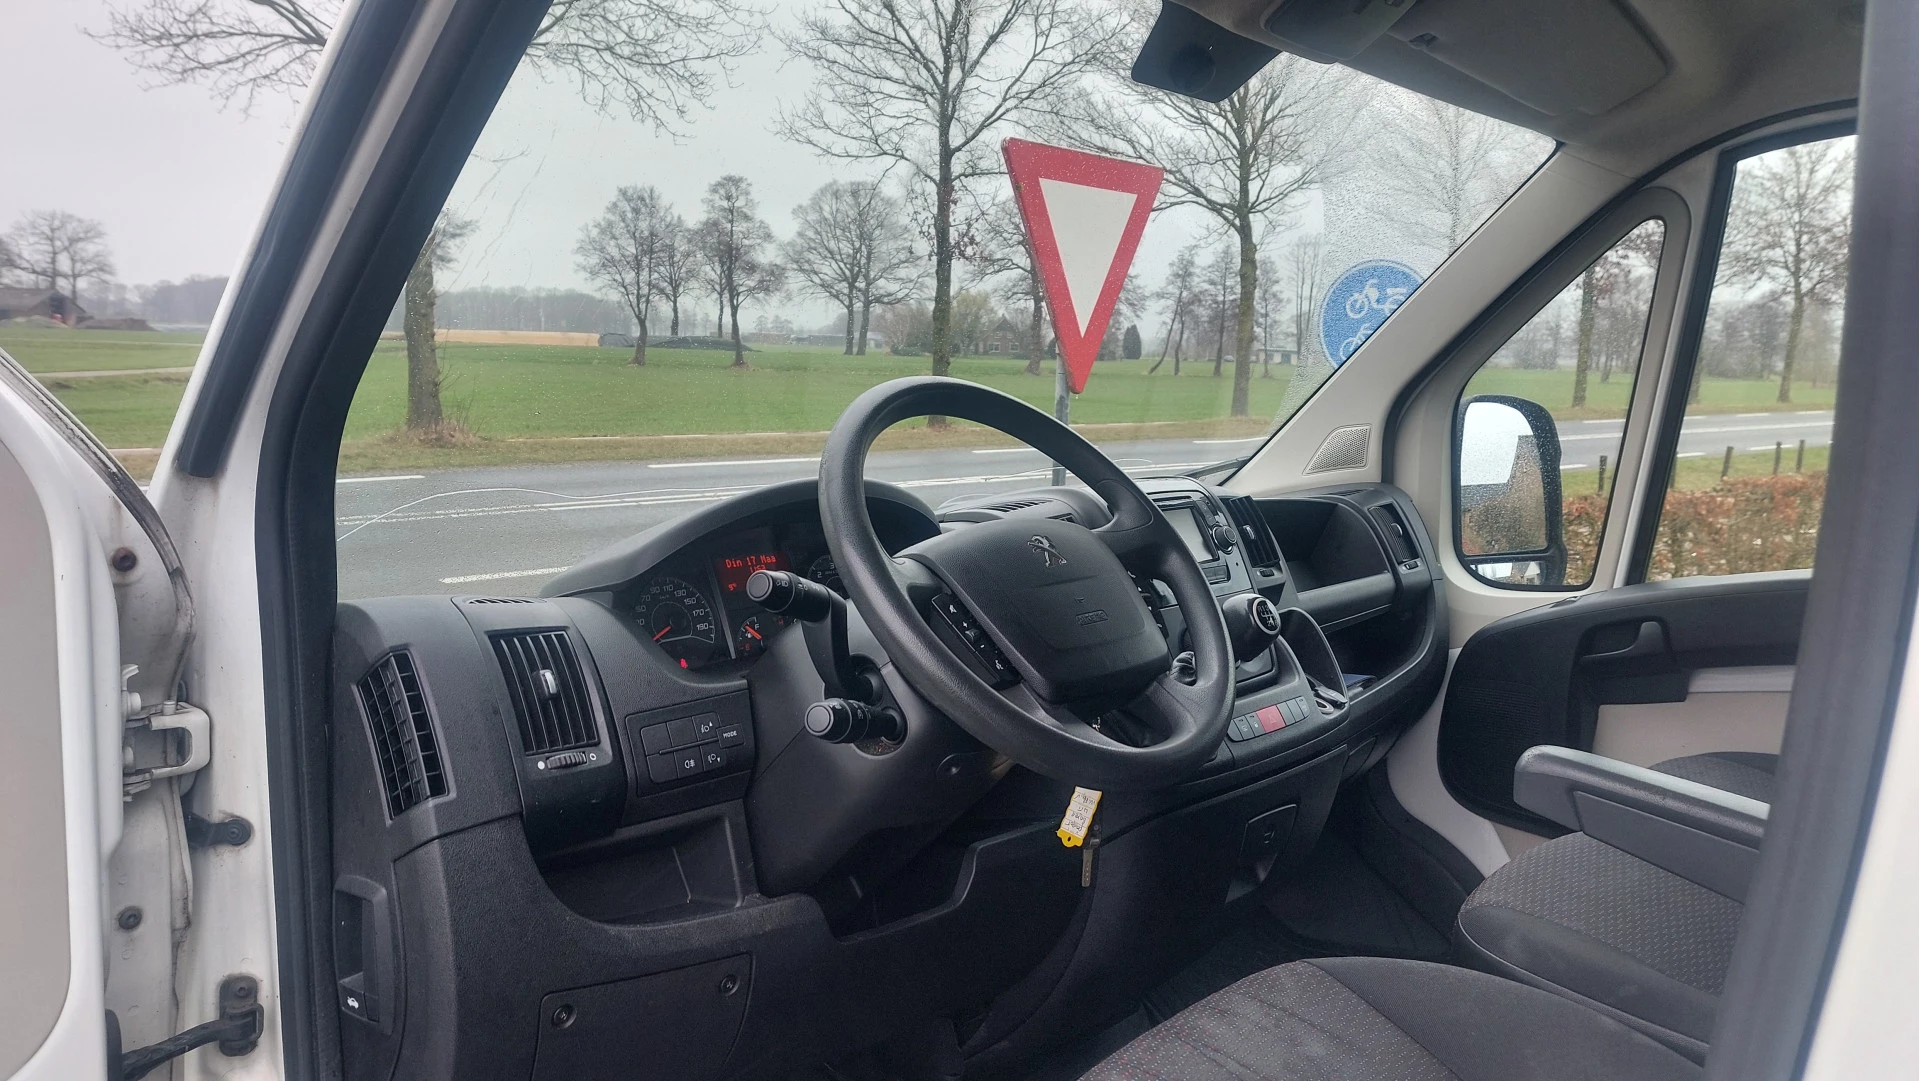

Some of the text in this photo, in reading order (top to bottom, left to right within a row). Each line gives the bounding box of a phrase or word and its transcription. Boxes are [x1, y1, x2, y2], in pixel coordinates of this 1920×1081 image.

[725, 555, 777, 568] Din 17 Maa
[663, 584, 674, 592] 110
[674, 589, 687, 597] 130
[684, 597, 697, 605] 150
[692, 609, 705, 617] 170
[696, 623, 709, 631] 190
[754, 623, 760, 631] F
[723, 730, 737, 739] MODE
